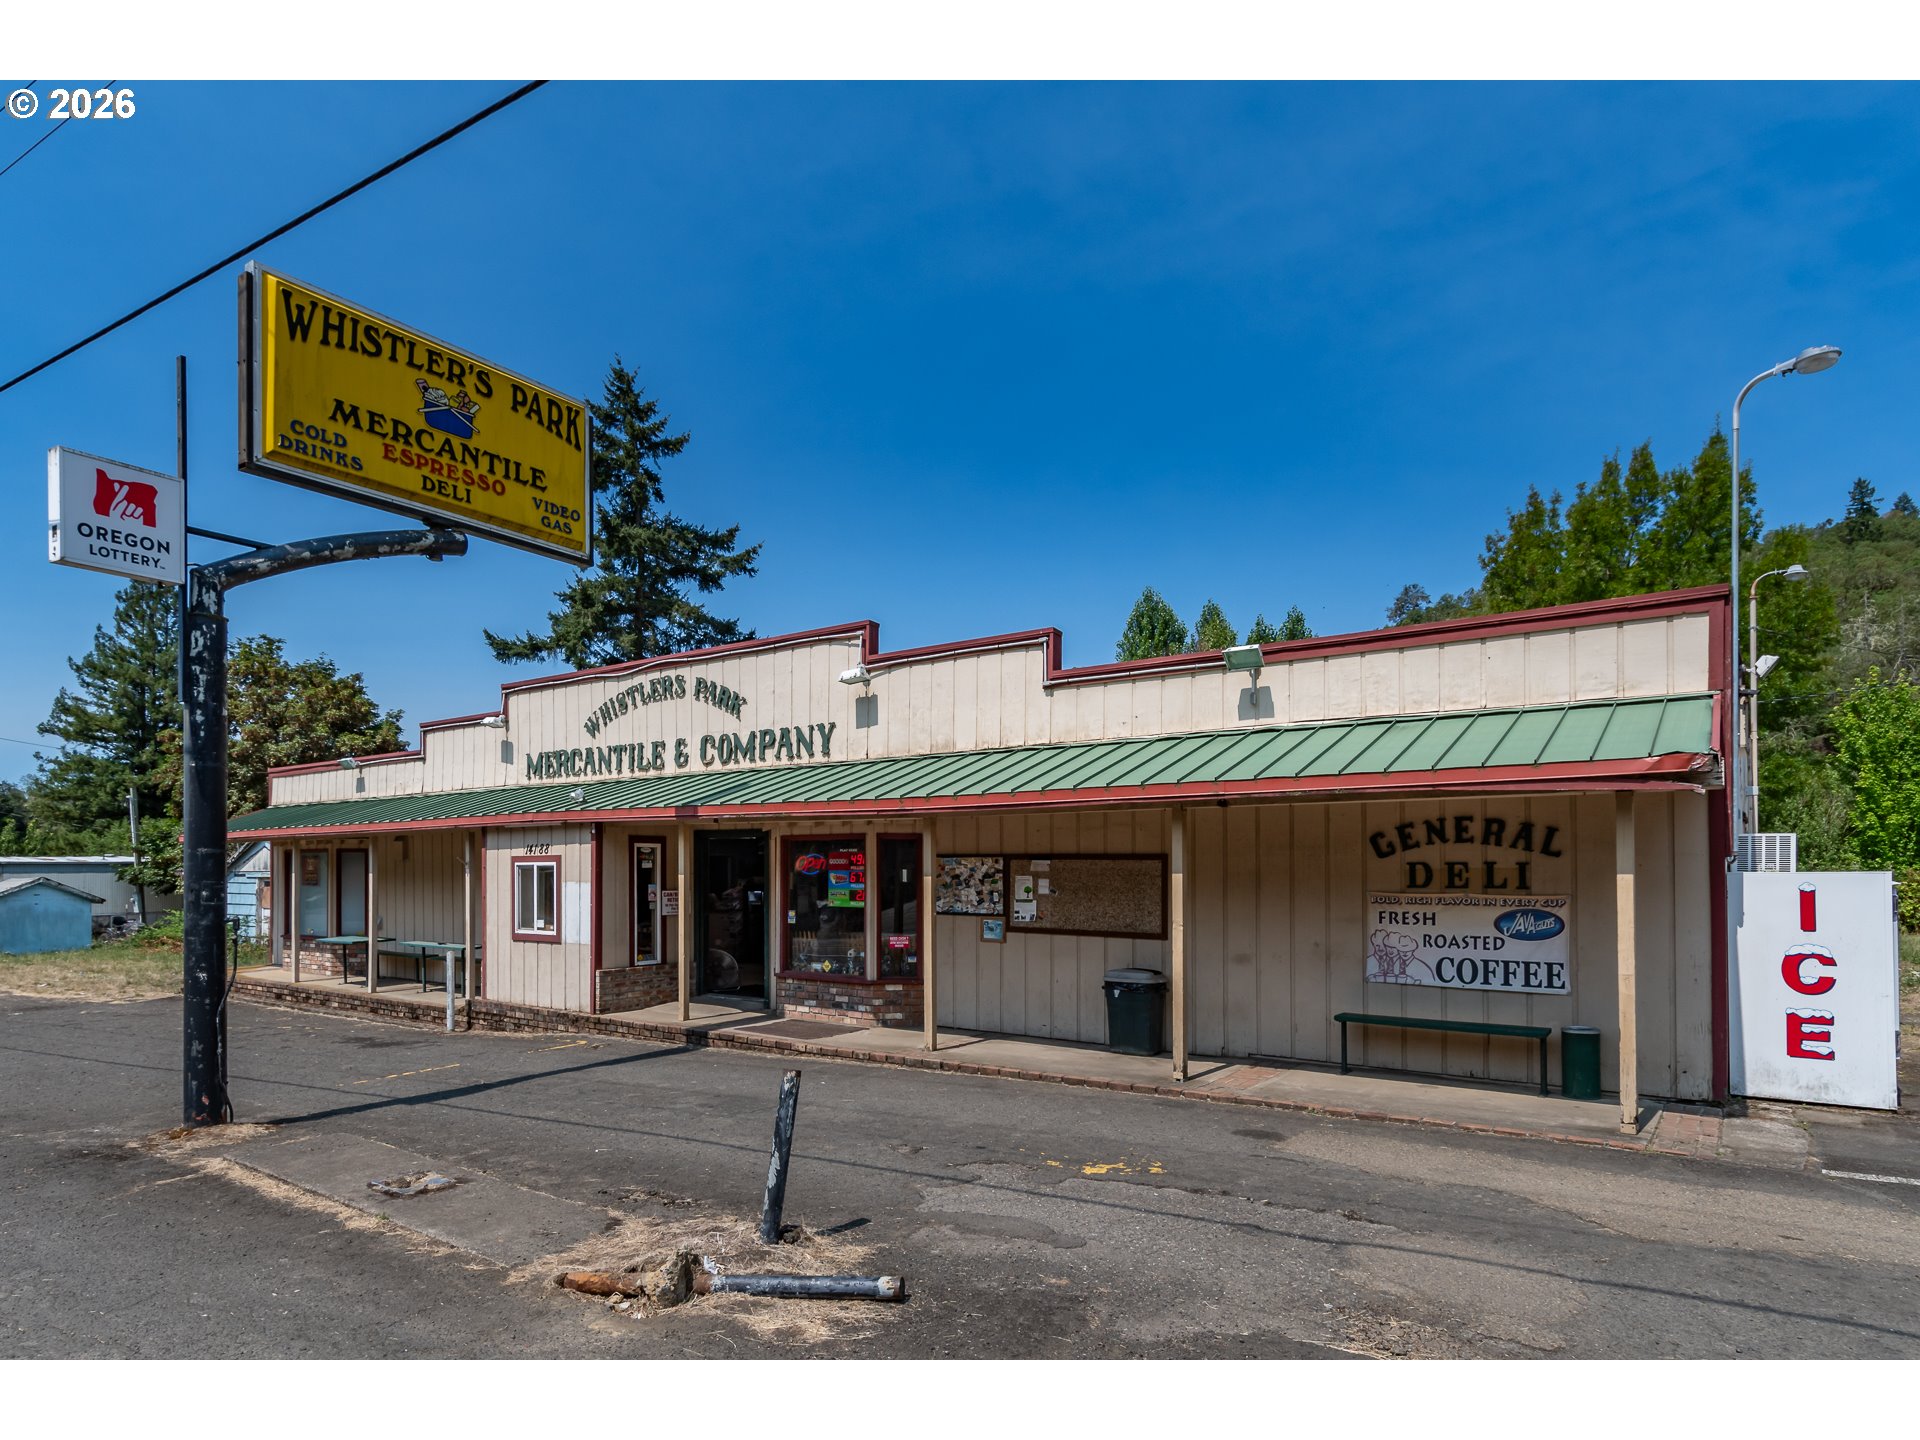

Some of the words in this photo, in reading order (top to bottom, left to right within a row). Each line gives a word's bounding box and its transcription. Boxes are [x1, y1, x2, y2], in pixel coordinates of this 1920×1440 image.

[281, 287, 493, 398] WHISTLER'S
[510, 383, 582, 452] PARK
[290, 419, 347, 448] COLD
[328, 398, 548, 492] MERCANTILE
[278, 433, 363, 471] DRINKS
[382, 442, 506, 496] ESPRESSO
[421, 475, 472, 504] DELI
[532, 497, 581, 522] VIDEO
[77, 522, 170, 555] OREGON
[540, 515, 573, 535] GAS
[89, 544, 160, 569] LOTTERY
[583, 674, 687, 740] WHISTLERS
[693, 677, 748, 721] PARK
[526, 740, 666, 781] MERCANTILE
[674, 737, 690, 769] &
[699, 722, 837, 767] COMPANY
[525, 843, 550, 855] 14188
[1369, 816, 1562, 859] GENERAL
[850, 853, 865, 865] 49
[849, 871, 865, 883] 67
[1406, 861, 1530, 890] DELI
[1370, 896, 1402, 906] BOLD,
[1405, 896, 1431, 905] RICH
[1434, 897, 1479, 906] FLAVOR
[1481, 898, 1497, 906] IN
[1500, 898, 1541, 907] EVERY
[1542, 899, 1566, 908] CUP
[1378, 911, 1436, 926] FRESH
[1423, 934, 1506, 951] ROASTED
[1435, 957, 1566, 990] COFFEE
[1781, 881, 1838, 1061] ICE
